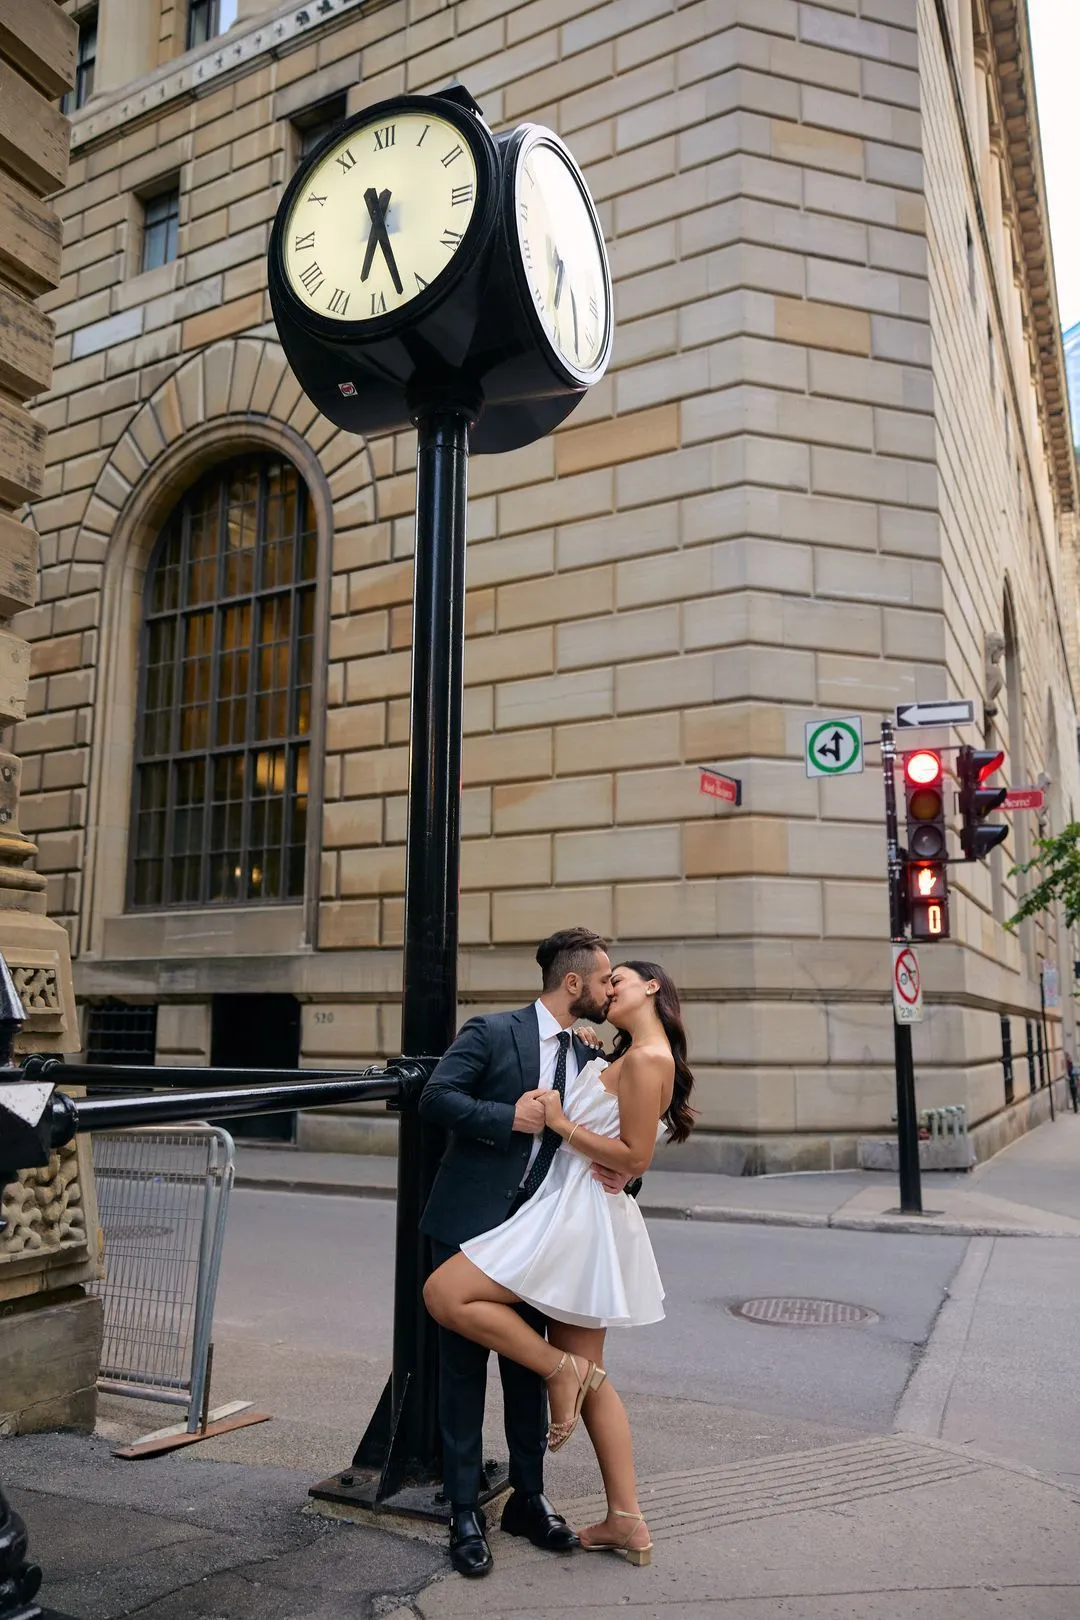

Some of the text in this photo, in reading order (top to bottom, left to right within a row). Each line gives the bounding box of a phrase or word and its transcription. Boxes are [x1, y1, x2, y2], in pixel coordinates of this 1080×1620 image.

[372, 124, 396, 152] XII
[335, 149, 358, 174] XI
[440, 144, 464, 168] II
[307, 192, 328, 206] X
[451, 184, 473, 206] III
[295, 231, 316, 252] IX
[299, 261, 325, 297] VIII
[326, 288, 350, 316] VII
[370, 291, 387, 315] VI
[928, 905, 942, 934] 0
